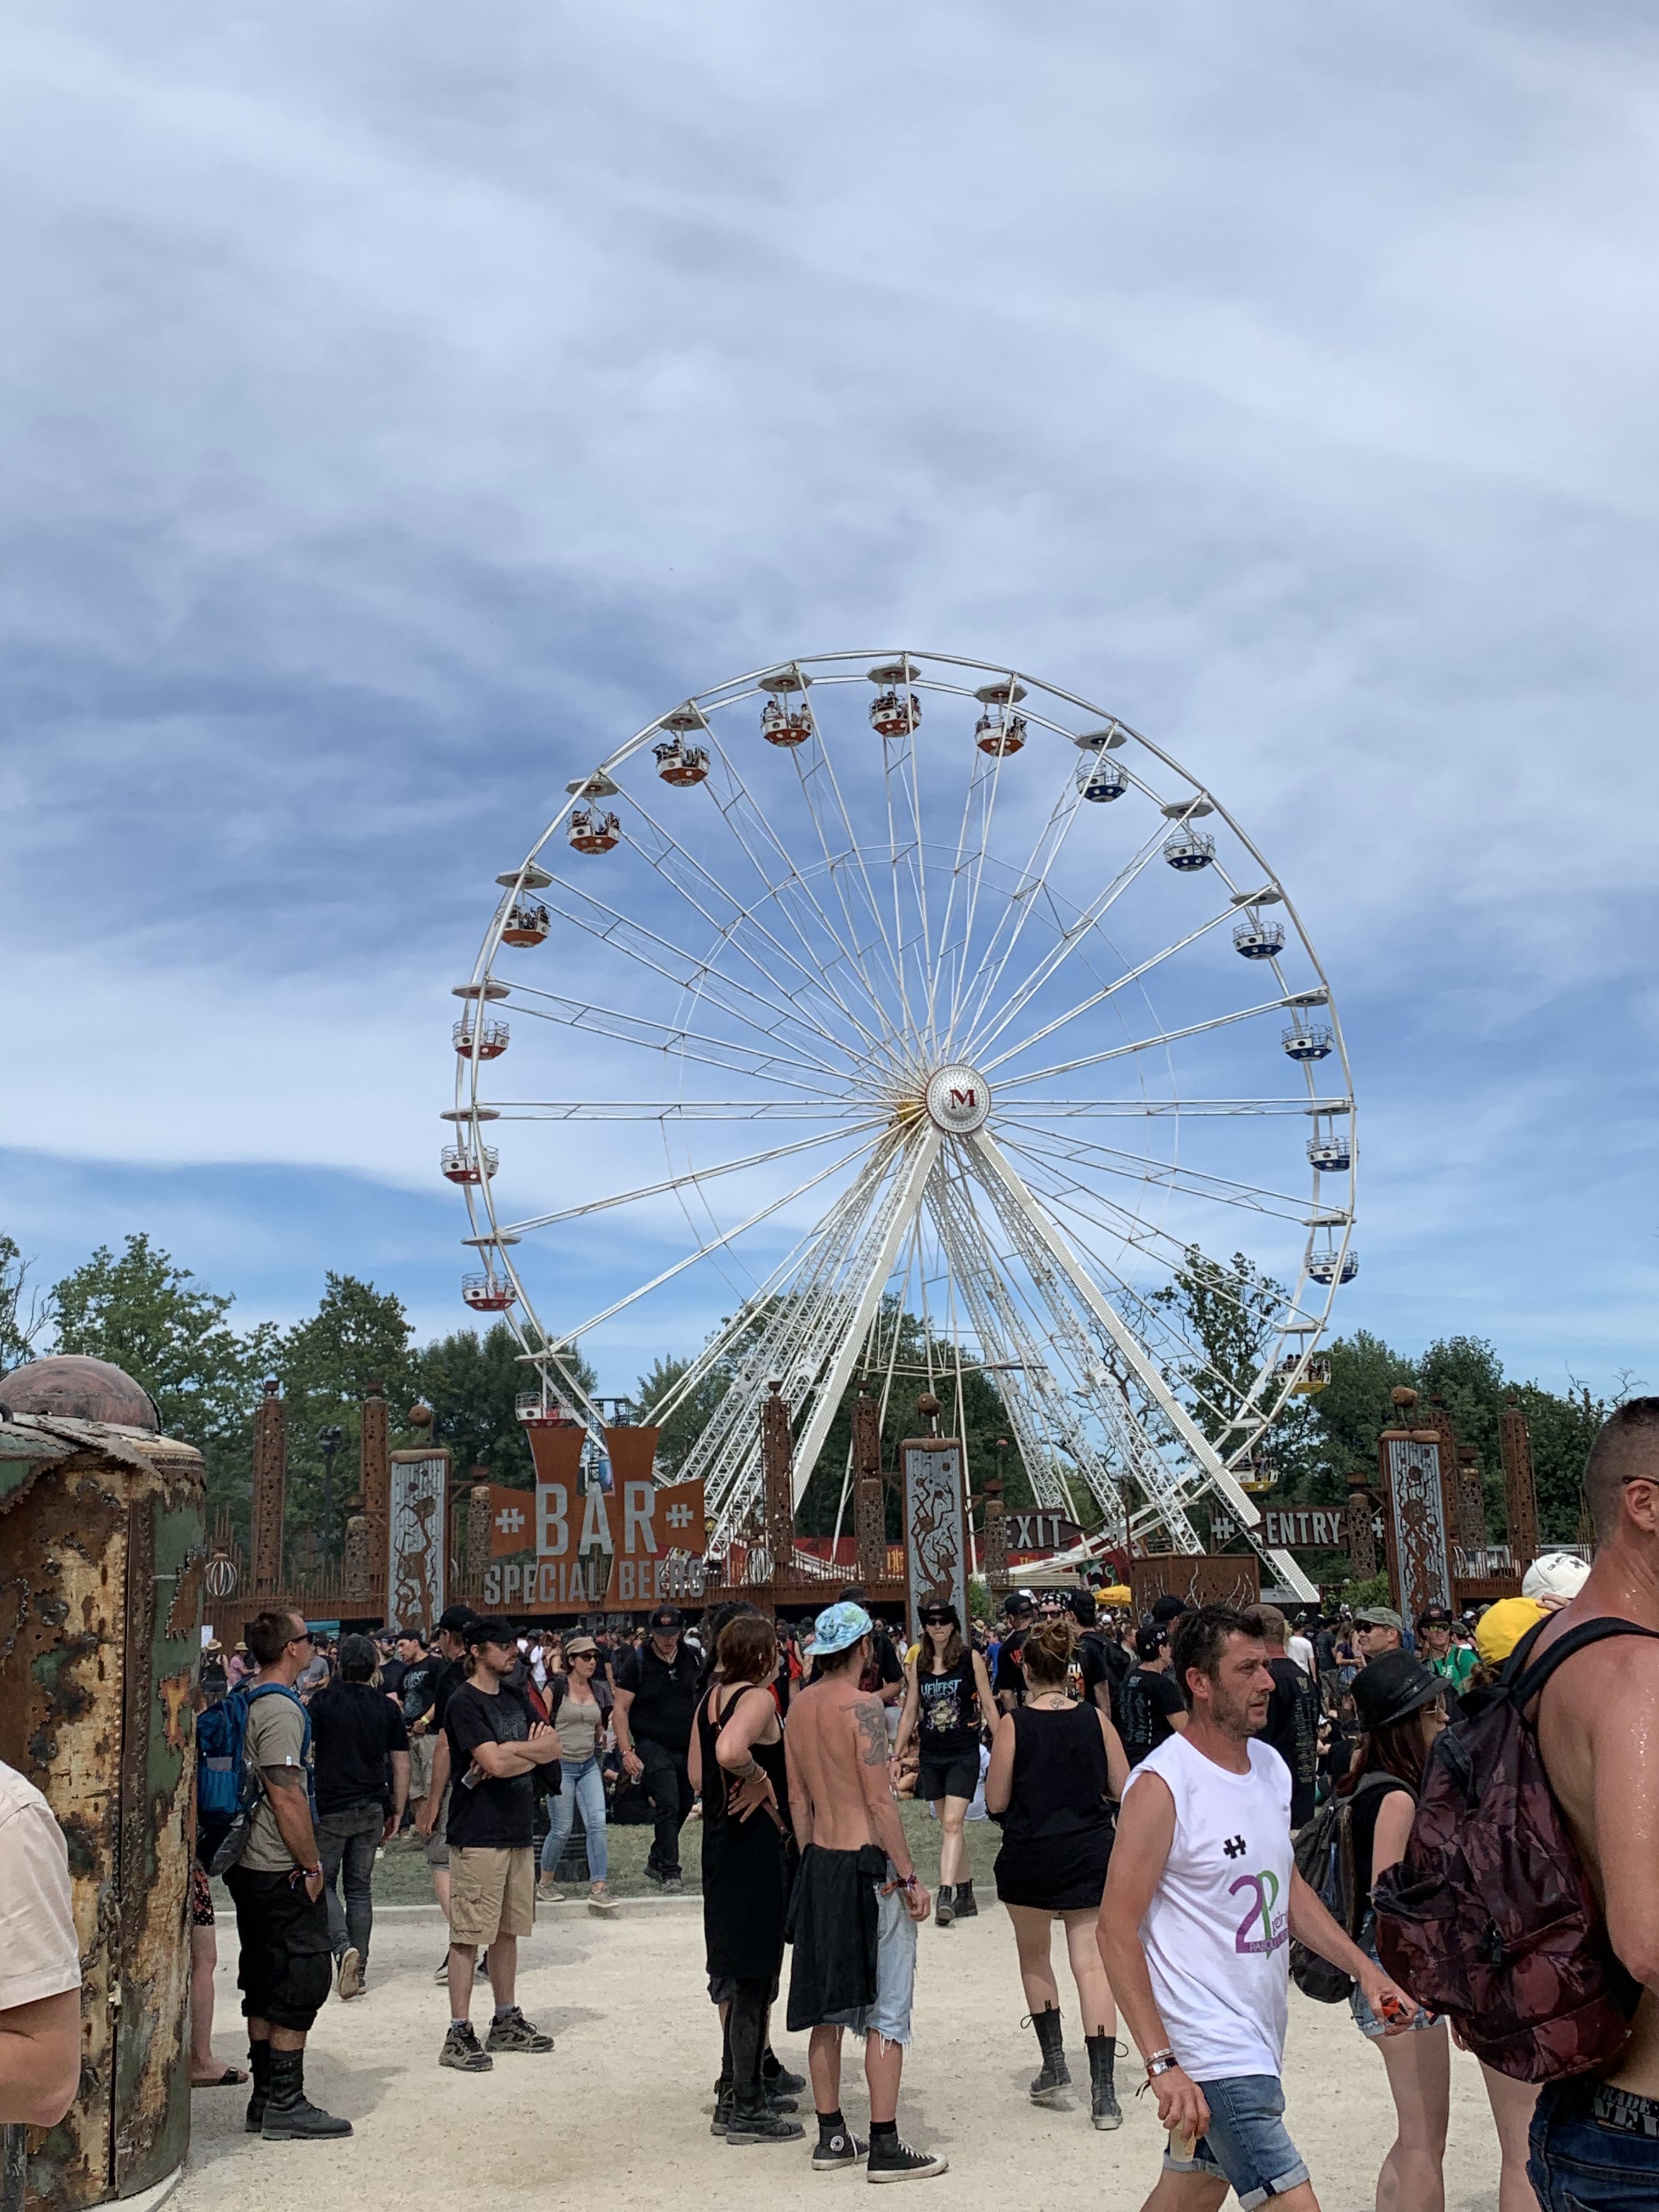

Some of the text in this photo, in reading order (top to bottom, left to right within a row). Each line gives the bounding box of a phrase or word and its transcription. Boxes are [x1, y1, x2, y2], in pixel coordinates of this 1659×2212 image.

[950, 1089, 976, 1109] M
[535, 1481, 658, 1556] BAR
[1266, 1512, 1340, 1544] ENTRY
[484, 1562, 600, 1605] SPECIAL
[619, 1558, 704, 1600] BEERS
